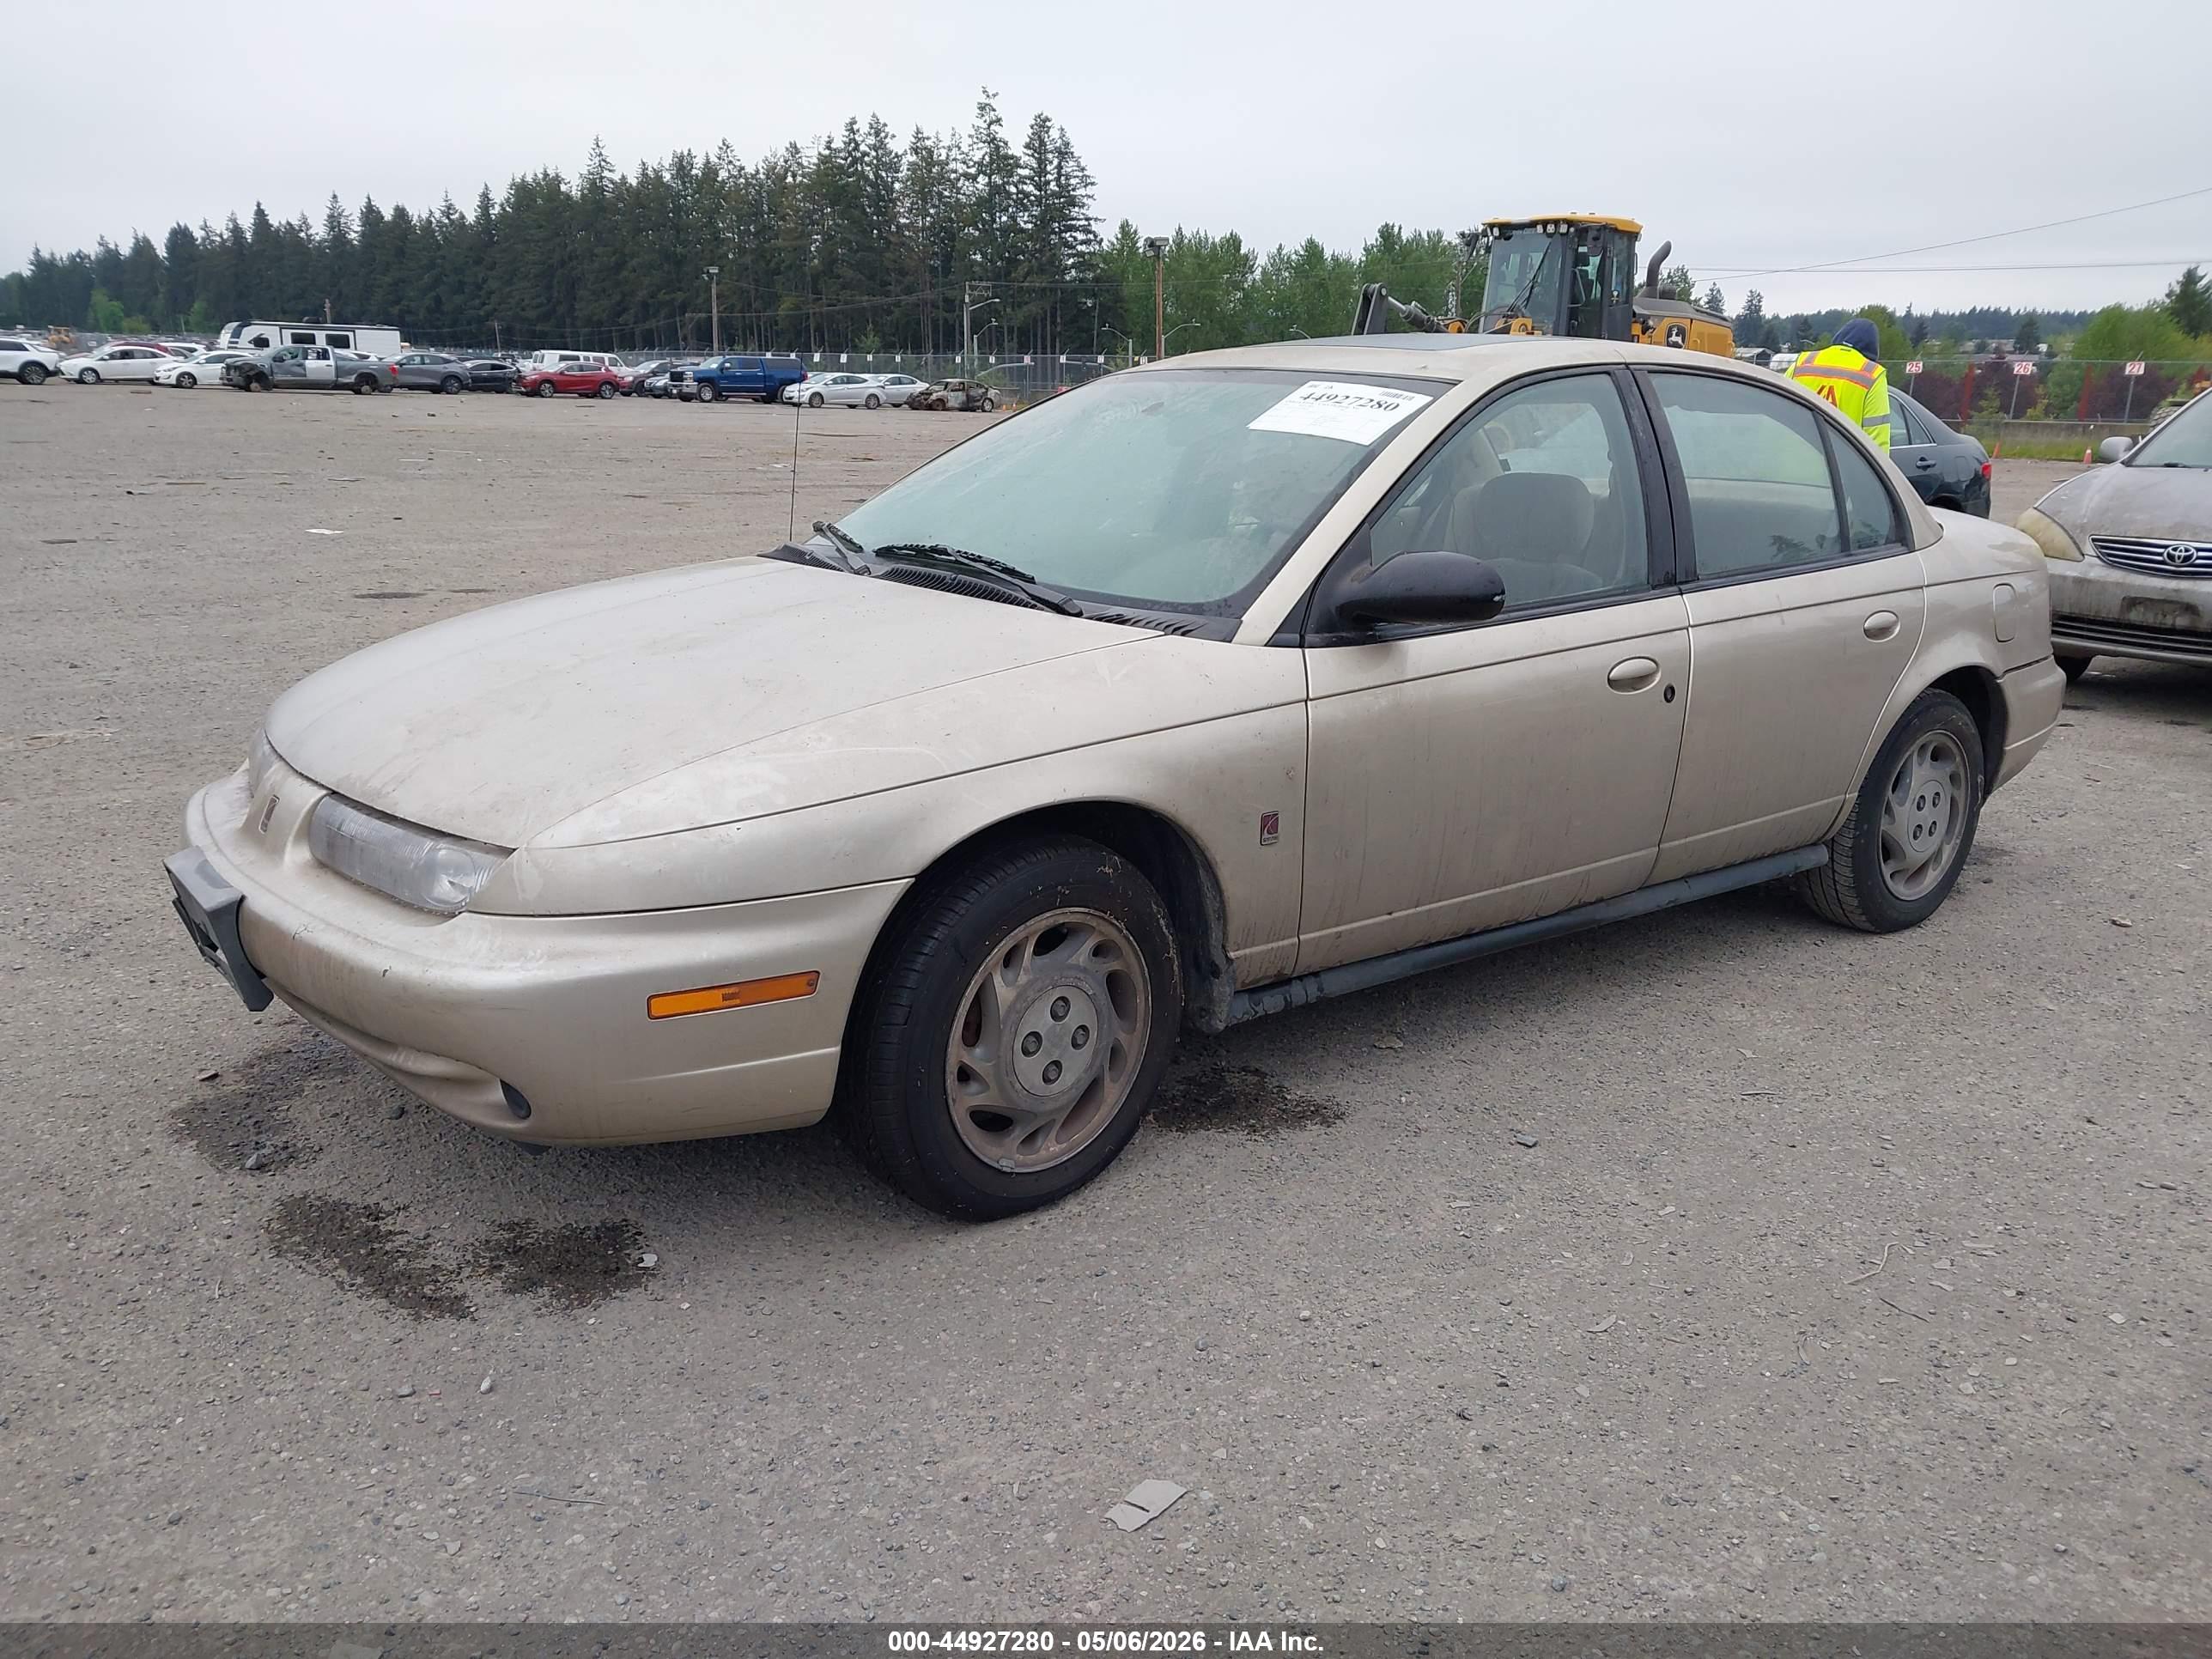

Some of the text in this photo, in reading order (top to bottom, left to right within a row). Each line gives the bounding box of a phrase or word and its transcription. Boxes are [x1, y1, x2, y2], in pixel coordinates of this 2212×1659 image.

[1908, 362, 1921, 372] 25
[2015, 362, 2030, 374] 26
[2129, 362, 2143, 374] 27
[1300, 392, 1400, 411] 44927280
